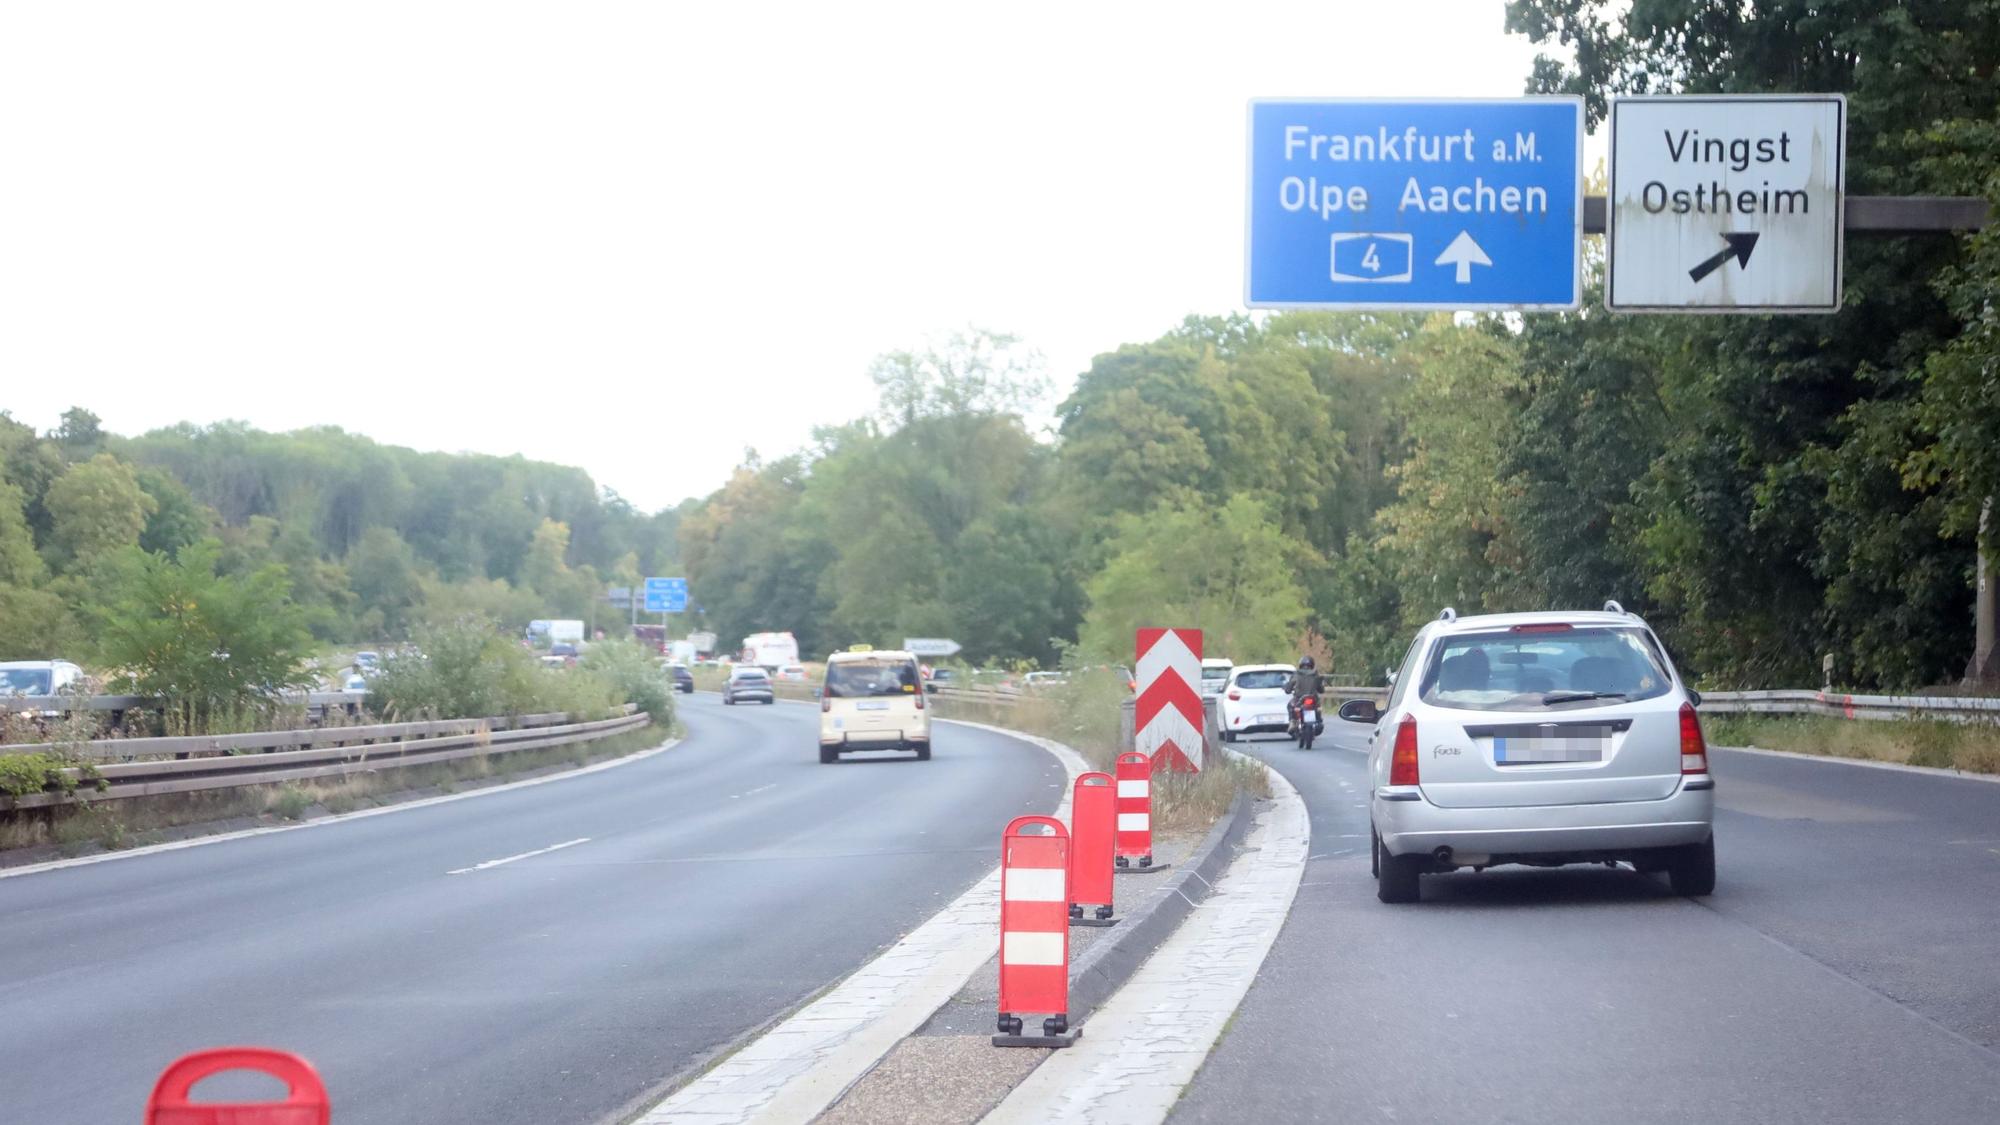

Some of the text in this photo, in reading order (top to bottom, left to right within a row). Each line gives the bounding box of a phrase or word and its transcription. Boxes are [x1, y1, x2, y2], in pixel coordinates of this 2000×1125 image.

[1283, 122, 1542, 162] Frankfurt a.M.
[1664, 130, 1790, 172] Vingst
[1279, 176, 1547, 220] Olpe Aachen
[1642, 181, 1809, 215] Ostheim
[1361, 243, 1380, 272] 4
